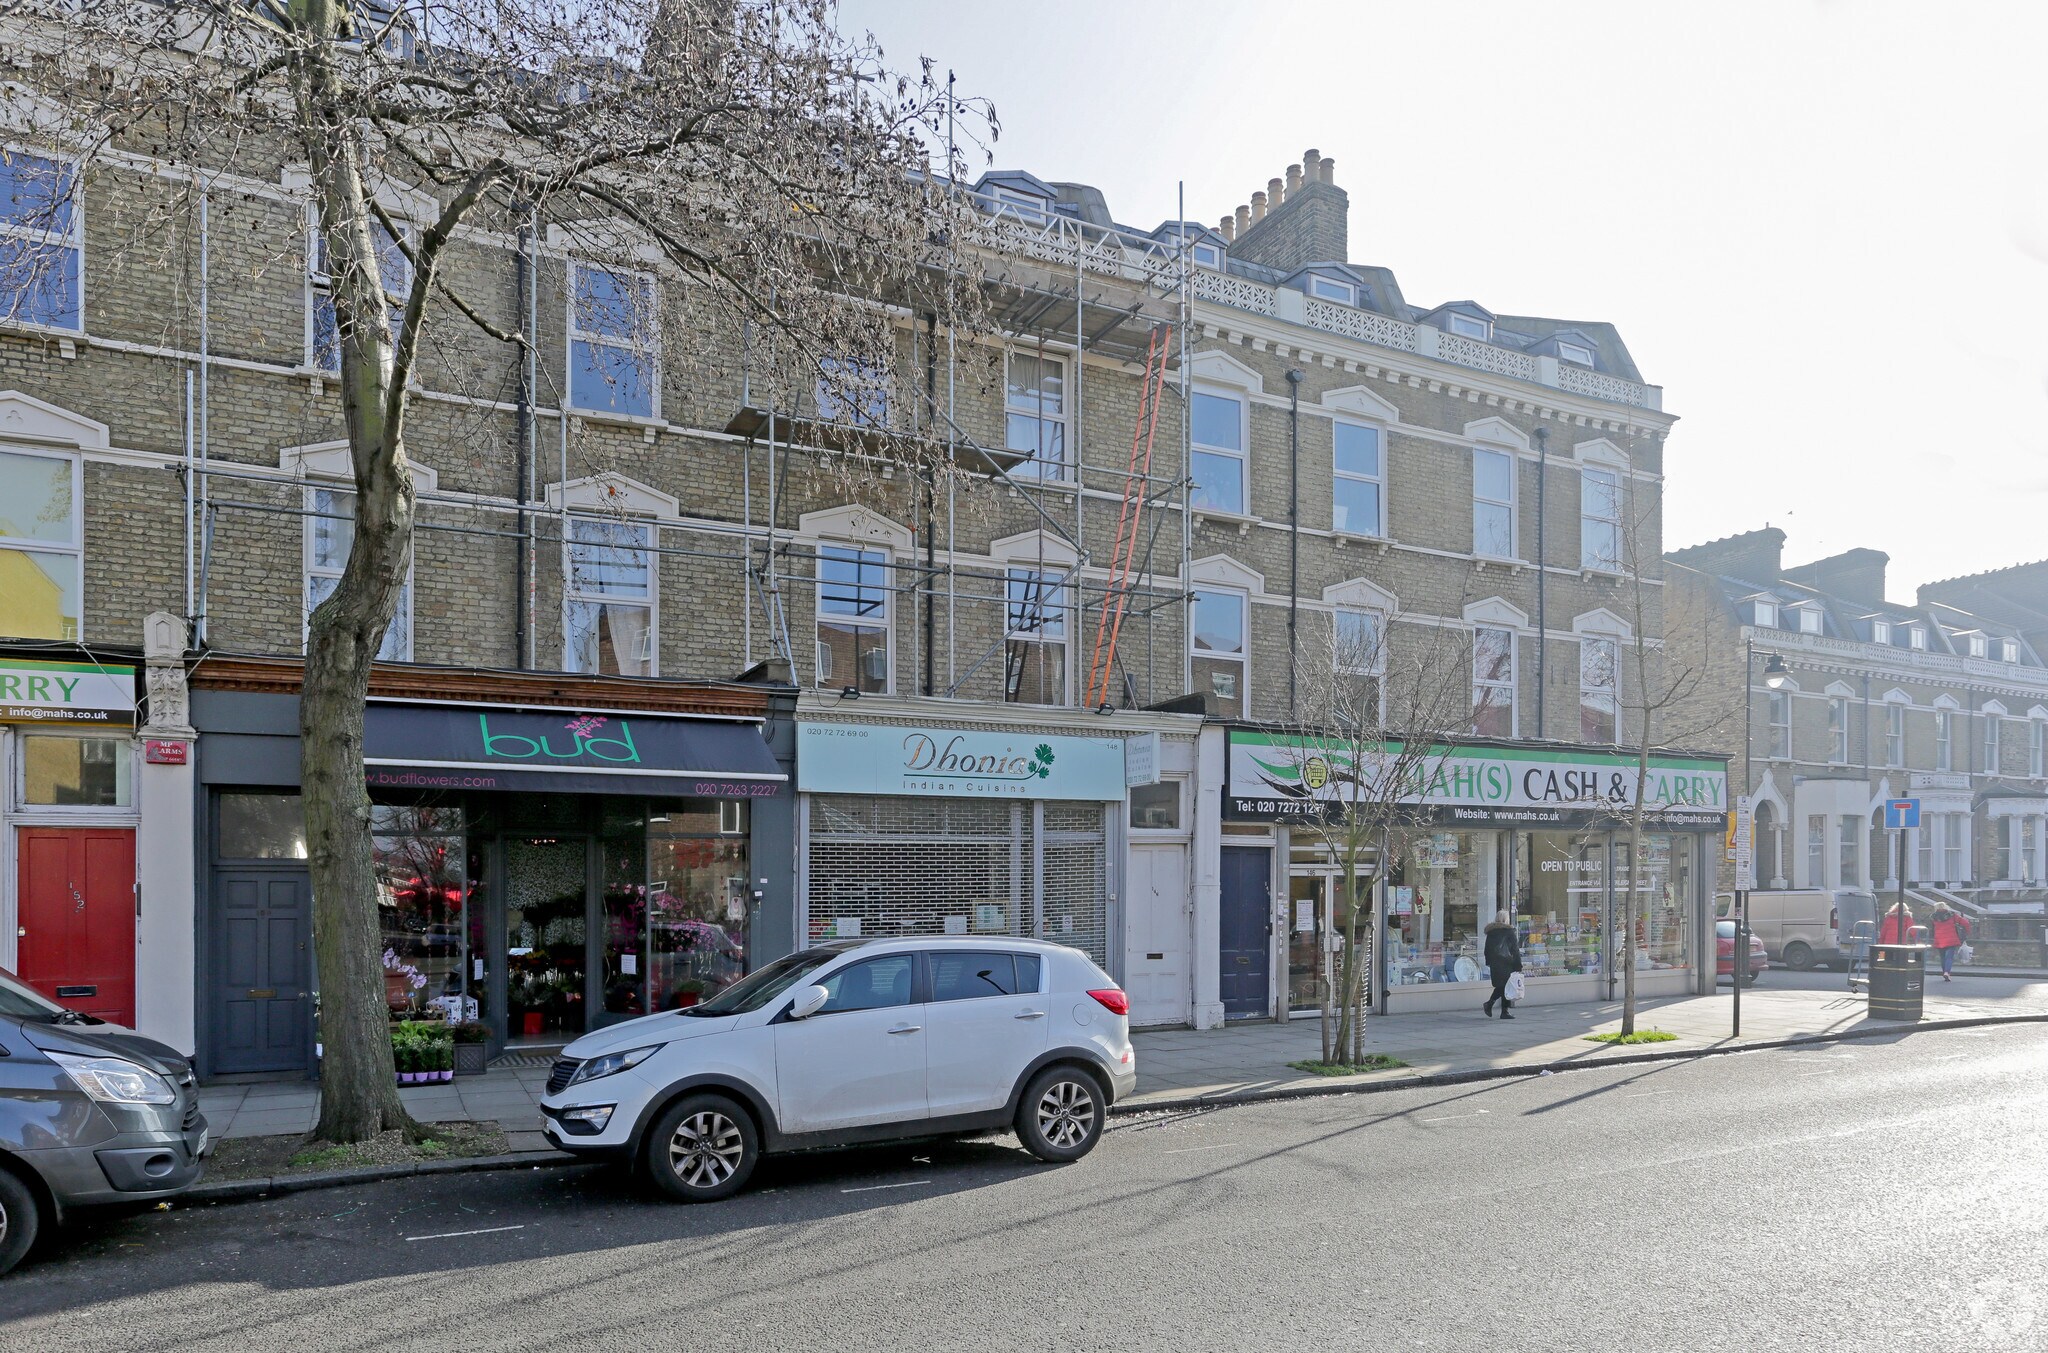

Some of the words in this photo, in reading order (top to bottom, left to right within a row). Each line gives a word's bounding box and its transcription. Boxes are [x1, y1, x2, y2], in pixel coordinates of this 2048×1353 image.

[9, 708, 108, 720] info@mahs.co.uk
[479, 714, 641, 762] bud
[903, 733, 1028, 775] Dhonia
[695, 783, 717, 795] 020
[720, 784, 748, 796] 7263
[750, 785, 777, 796] 2227
[903, 781, 955, 790] Indian
[1523, 768, 1598, 802] CASH
[1608, 772, 1627, 804] &
[1236, 800, 1254, 812] Tel:
[1257, 801, 1275, 813] 020
[1278, 802, 1300, 813] 7272
[1454, 808, 1490, 819] Website:
[1494, 810, 1560, 821] www.mahs.co.uk
[1664, 814, 1721, 825] info@mahs.co.uk
[1541, 861, 1563, 872] OPEN
[1564, 861, 1574, 871] TO
[1575, 861, 1602, 871] PUBLIC
